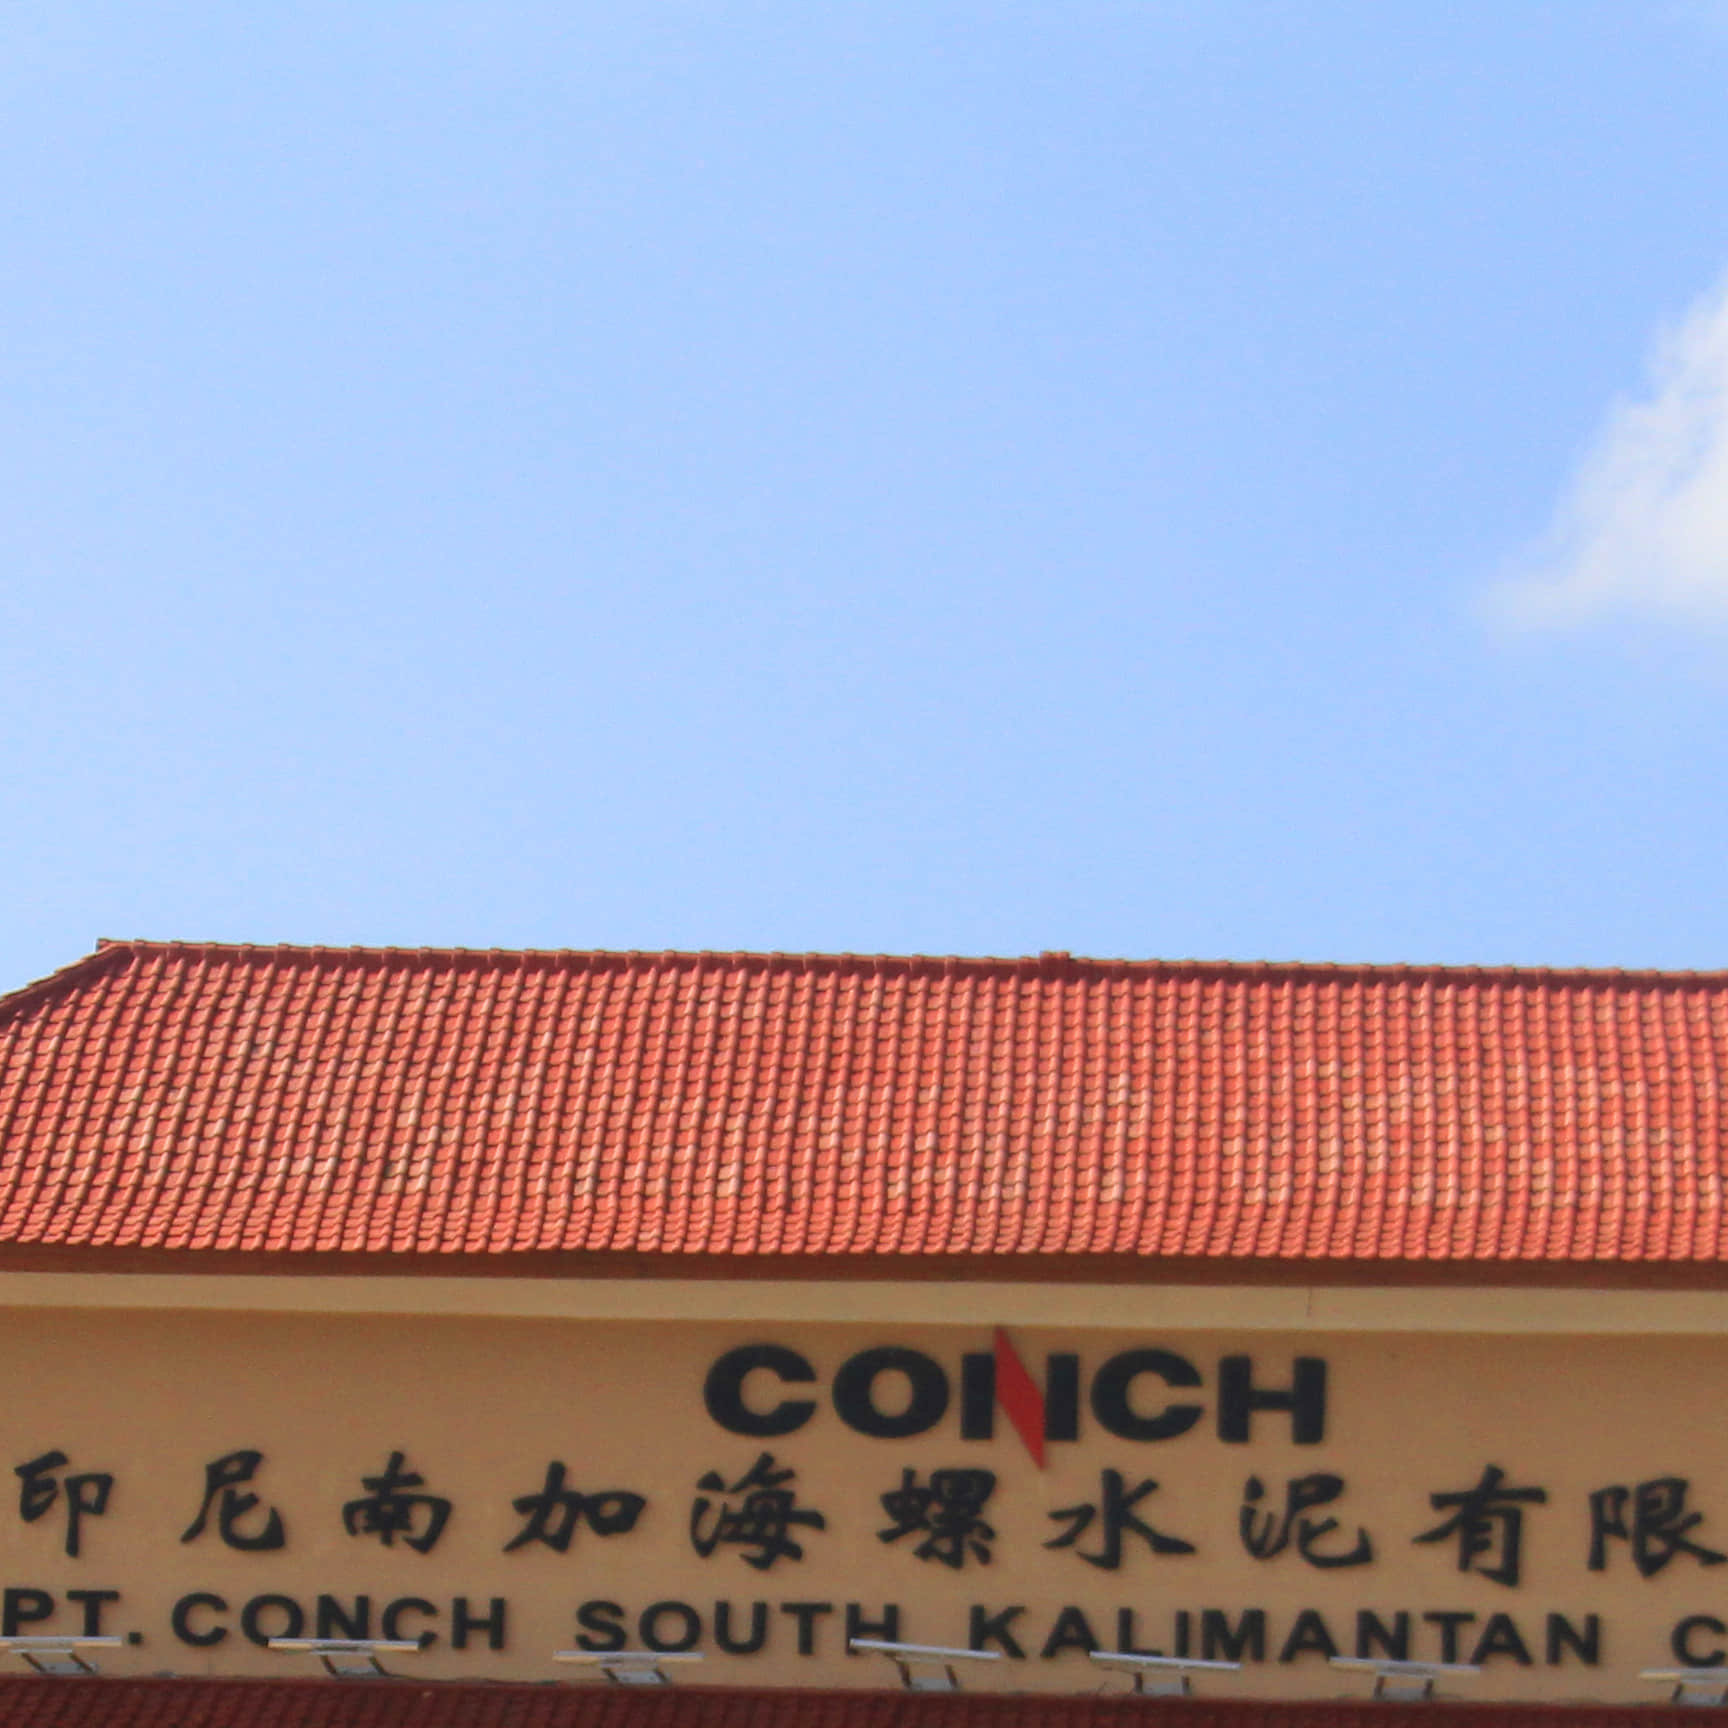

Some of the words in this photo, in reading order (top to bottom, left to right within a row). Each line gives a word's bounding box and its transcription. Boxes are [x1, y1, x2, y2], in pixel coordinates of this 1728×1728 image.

[703, 1326, 1328, 1472] CONCH
[2, 1587, 142, 1646] PT.
[171, 1592, 506, 1651] CONCH
[575, 1600, 900, 1656] SOUTH
[969, 1604, 1601, 1668] KALIMANTAN
